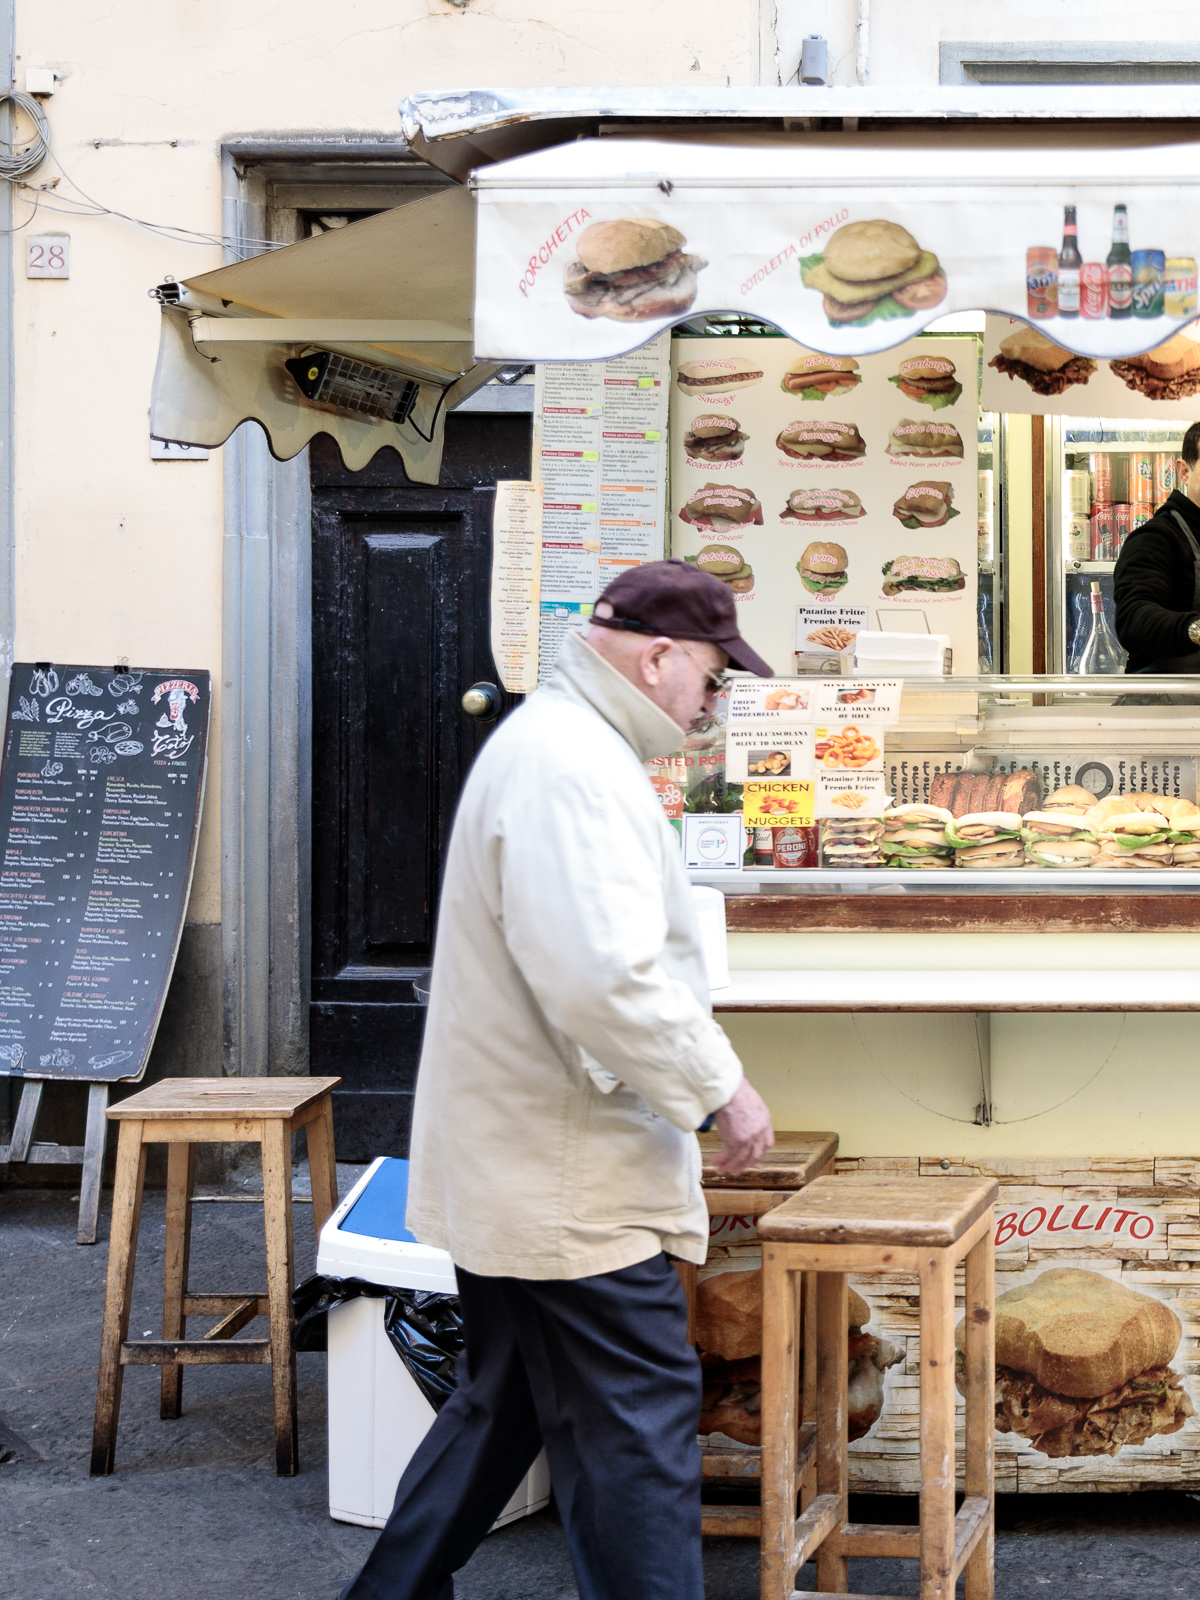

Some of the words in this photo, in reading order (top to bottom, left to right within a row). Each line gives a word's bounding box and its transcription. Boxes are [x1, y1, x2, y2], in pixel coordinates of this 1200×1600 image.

[28, 244, 65, 270] 28
[518, 207, 592, 298] PORCHETTA
[739, 243, 797, 297] COTOLETTA
[799, 231, 813, 249] DI
[812, 207, 851, 238] POLLO
[697, 360, 737, 371] Salsiccia
[804, 356, 841, 370] Hot-dog
[902, 359, 954, 373] Hamburger
[698, 394, 736, 406] Sausage
[692, 417, 737, 431] Porchetta
[783, 422, 813, 436] Salame
[895, 426, 916, 437] Cotto
[926, 424, 958, 437] Fontina
[685, 457, 722, 471] Roasted
[724, 459, 744, 469] Pork
[777, 459, 795, 469] Spicy
[796, 461, 822, 469] Salami
[824, 461, 840, 469] and
[841, 460, 864, 469] Cheese
[889, 459, 907, 468] Baked
[909, 460, 925, 468] Ham
[941, 459, 962, 468] Cheese
[779, 519, 795, 527] Ham,
[700, 533, 714, 541] and
[698, 552, 740, 565] Cotoletta
[814, 592, 836, 602] Tuna
[913, 596, 931, 604] Salad
[945, 595, 962, 603] Cheese
[799, 607, 837, 615] Patatine
[840, 608, 865, 616] Fritte
[804, 617, 835, 625] French
[154, 680, 199, 695] PIZZERIA
[45, 697, 116, 729] Pizza
[698, 754, 726, 767] POR
[747, 783, 810, 793] CHICKEN
[748, 816, 811, 826] NUGGETS
[776, 842, 807, 852] PERONI
[995, 1203, 1155, 1246] BOLLITO
